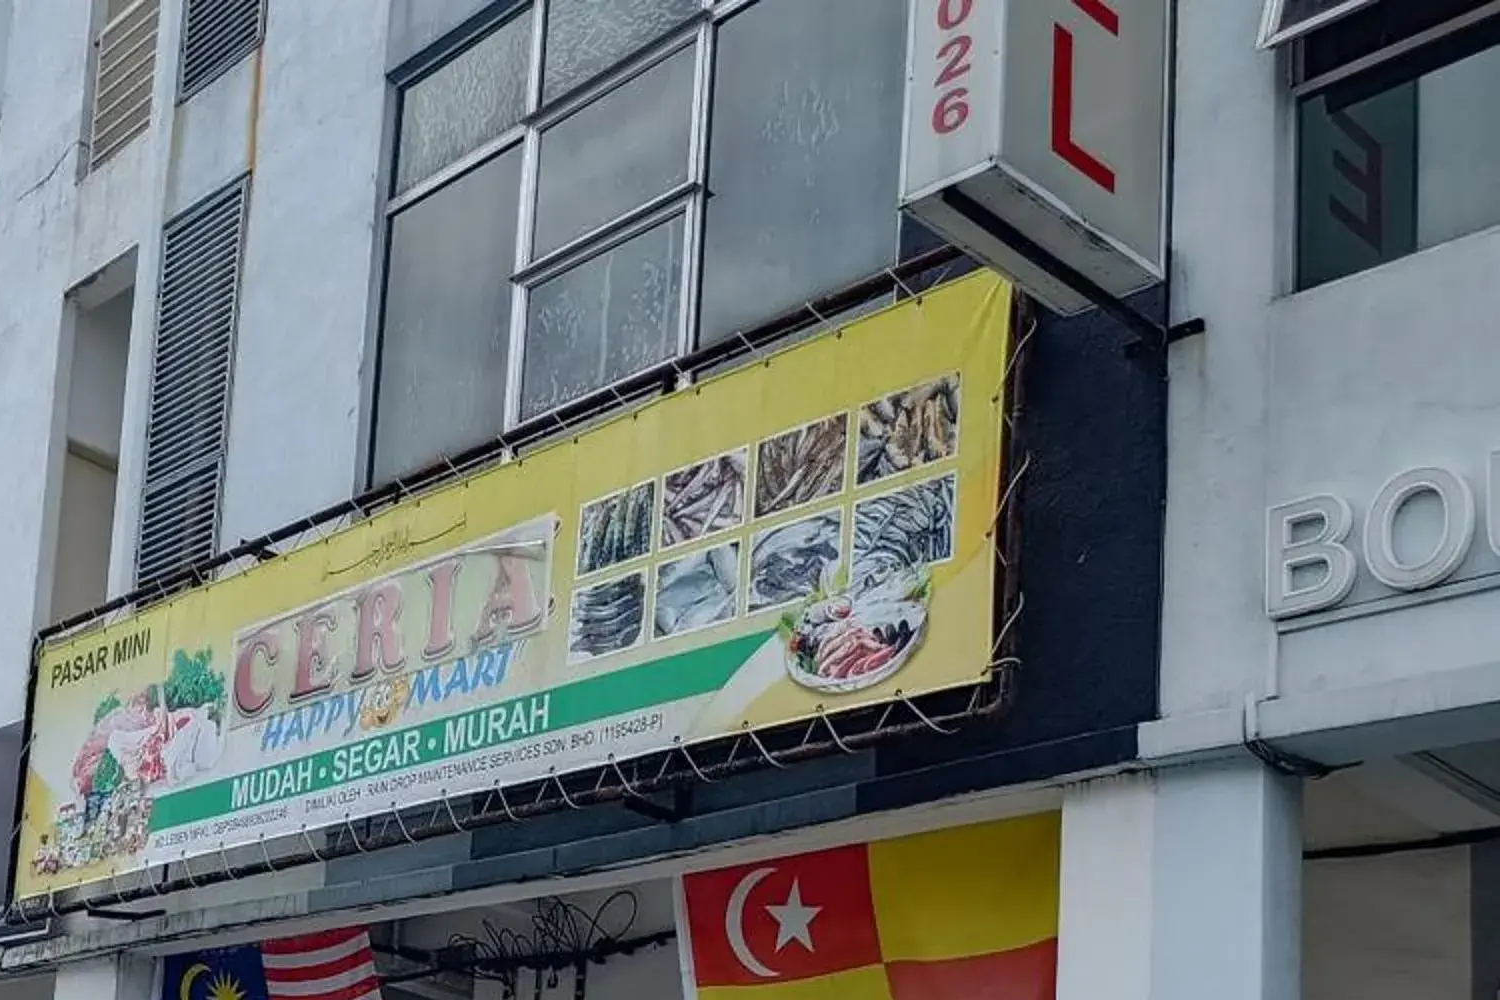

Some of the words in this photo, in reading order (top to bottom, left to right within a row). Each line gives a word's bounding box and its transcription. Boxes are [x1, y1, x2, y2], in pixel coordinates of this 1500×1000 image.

[1266, 449, 1500, 621] BO
[51, 645, 109, 689] PASAR
[113, 627, 151, 667] MINI
[234, 552, 544, 718] CERIA
[230, 758, 313, 810] MUDAH
[332, 730, 421, 782] SEGAR
[443, 693, 550, 755] MURAH
[488, 742, 541, 770] SERVICES
